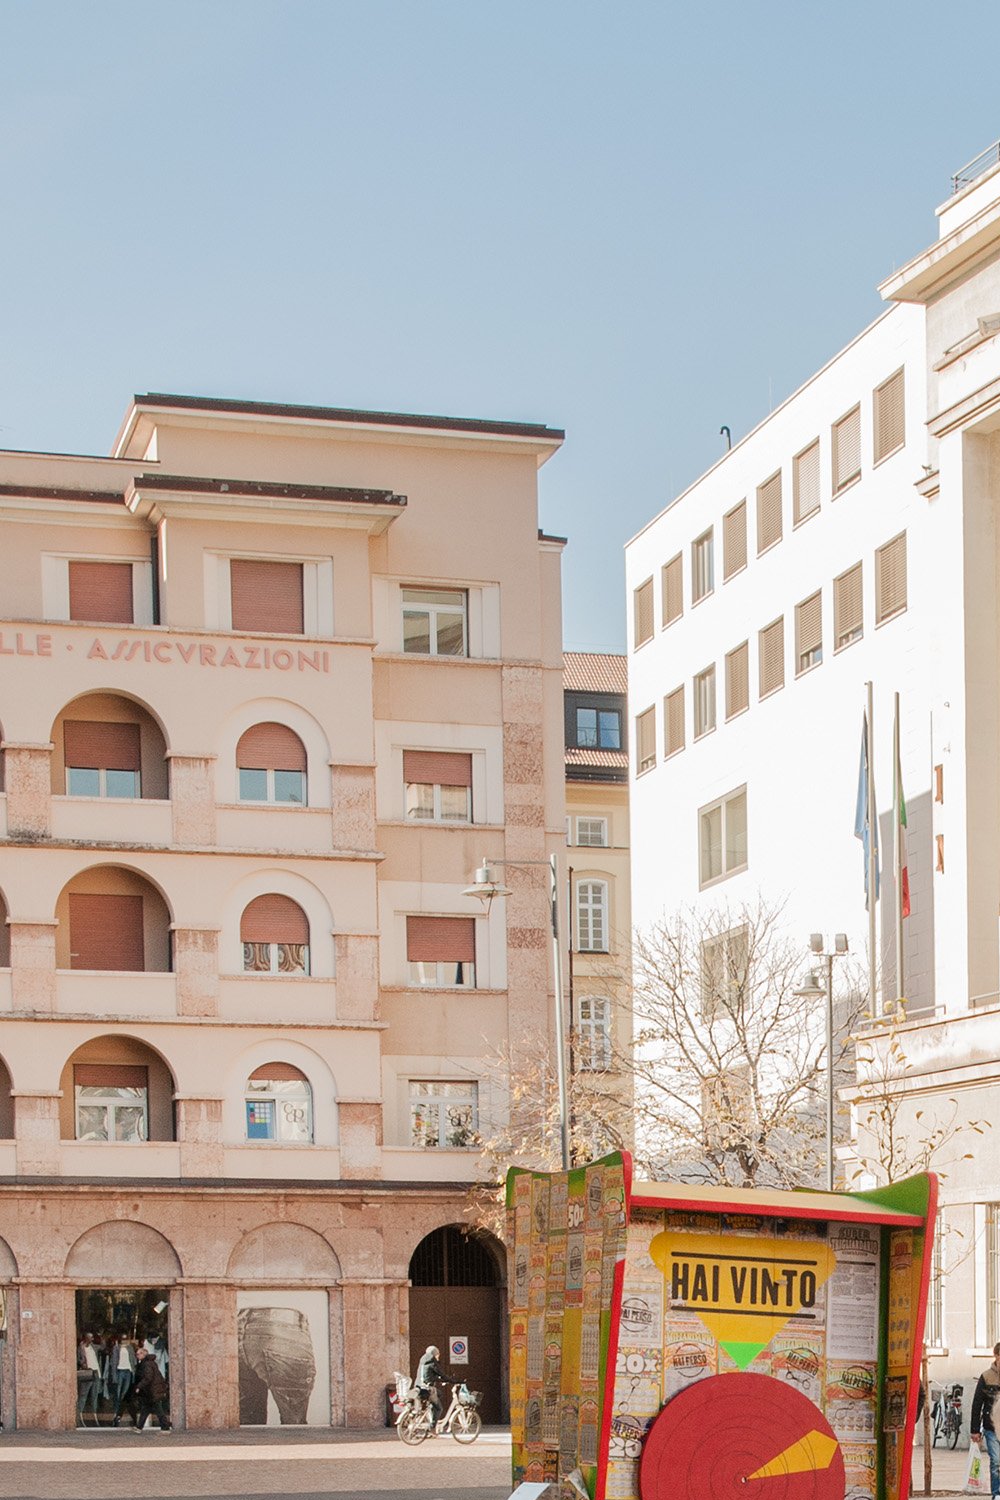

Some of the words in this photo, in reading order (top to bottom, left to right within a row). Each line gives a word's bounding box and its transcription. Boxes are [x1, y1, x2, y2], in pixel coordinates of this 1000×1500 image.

[87, 638, 331, 673] ASSICVRAZIONI
[839, 1227, 871, 1239] SUPER
[671, 1262, 720, 1303] HAI
[730, 1266, 817, 1309] VINTO
